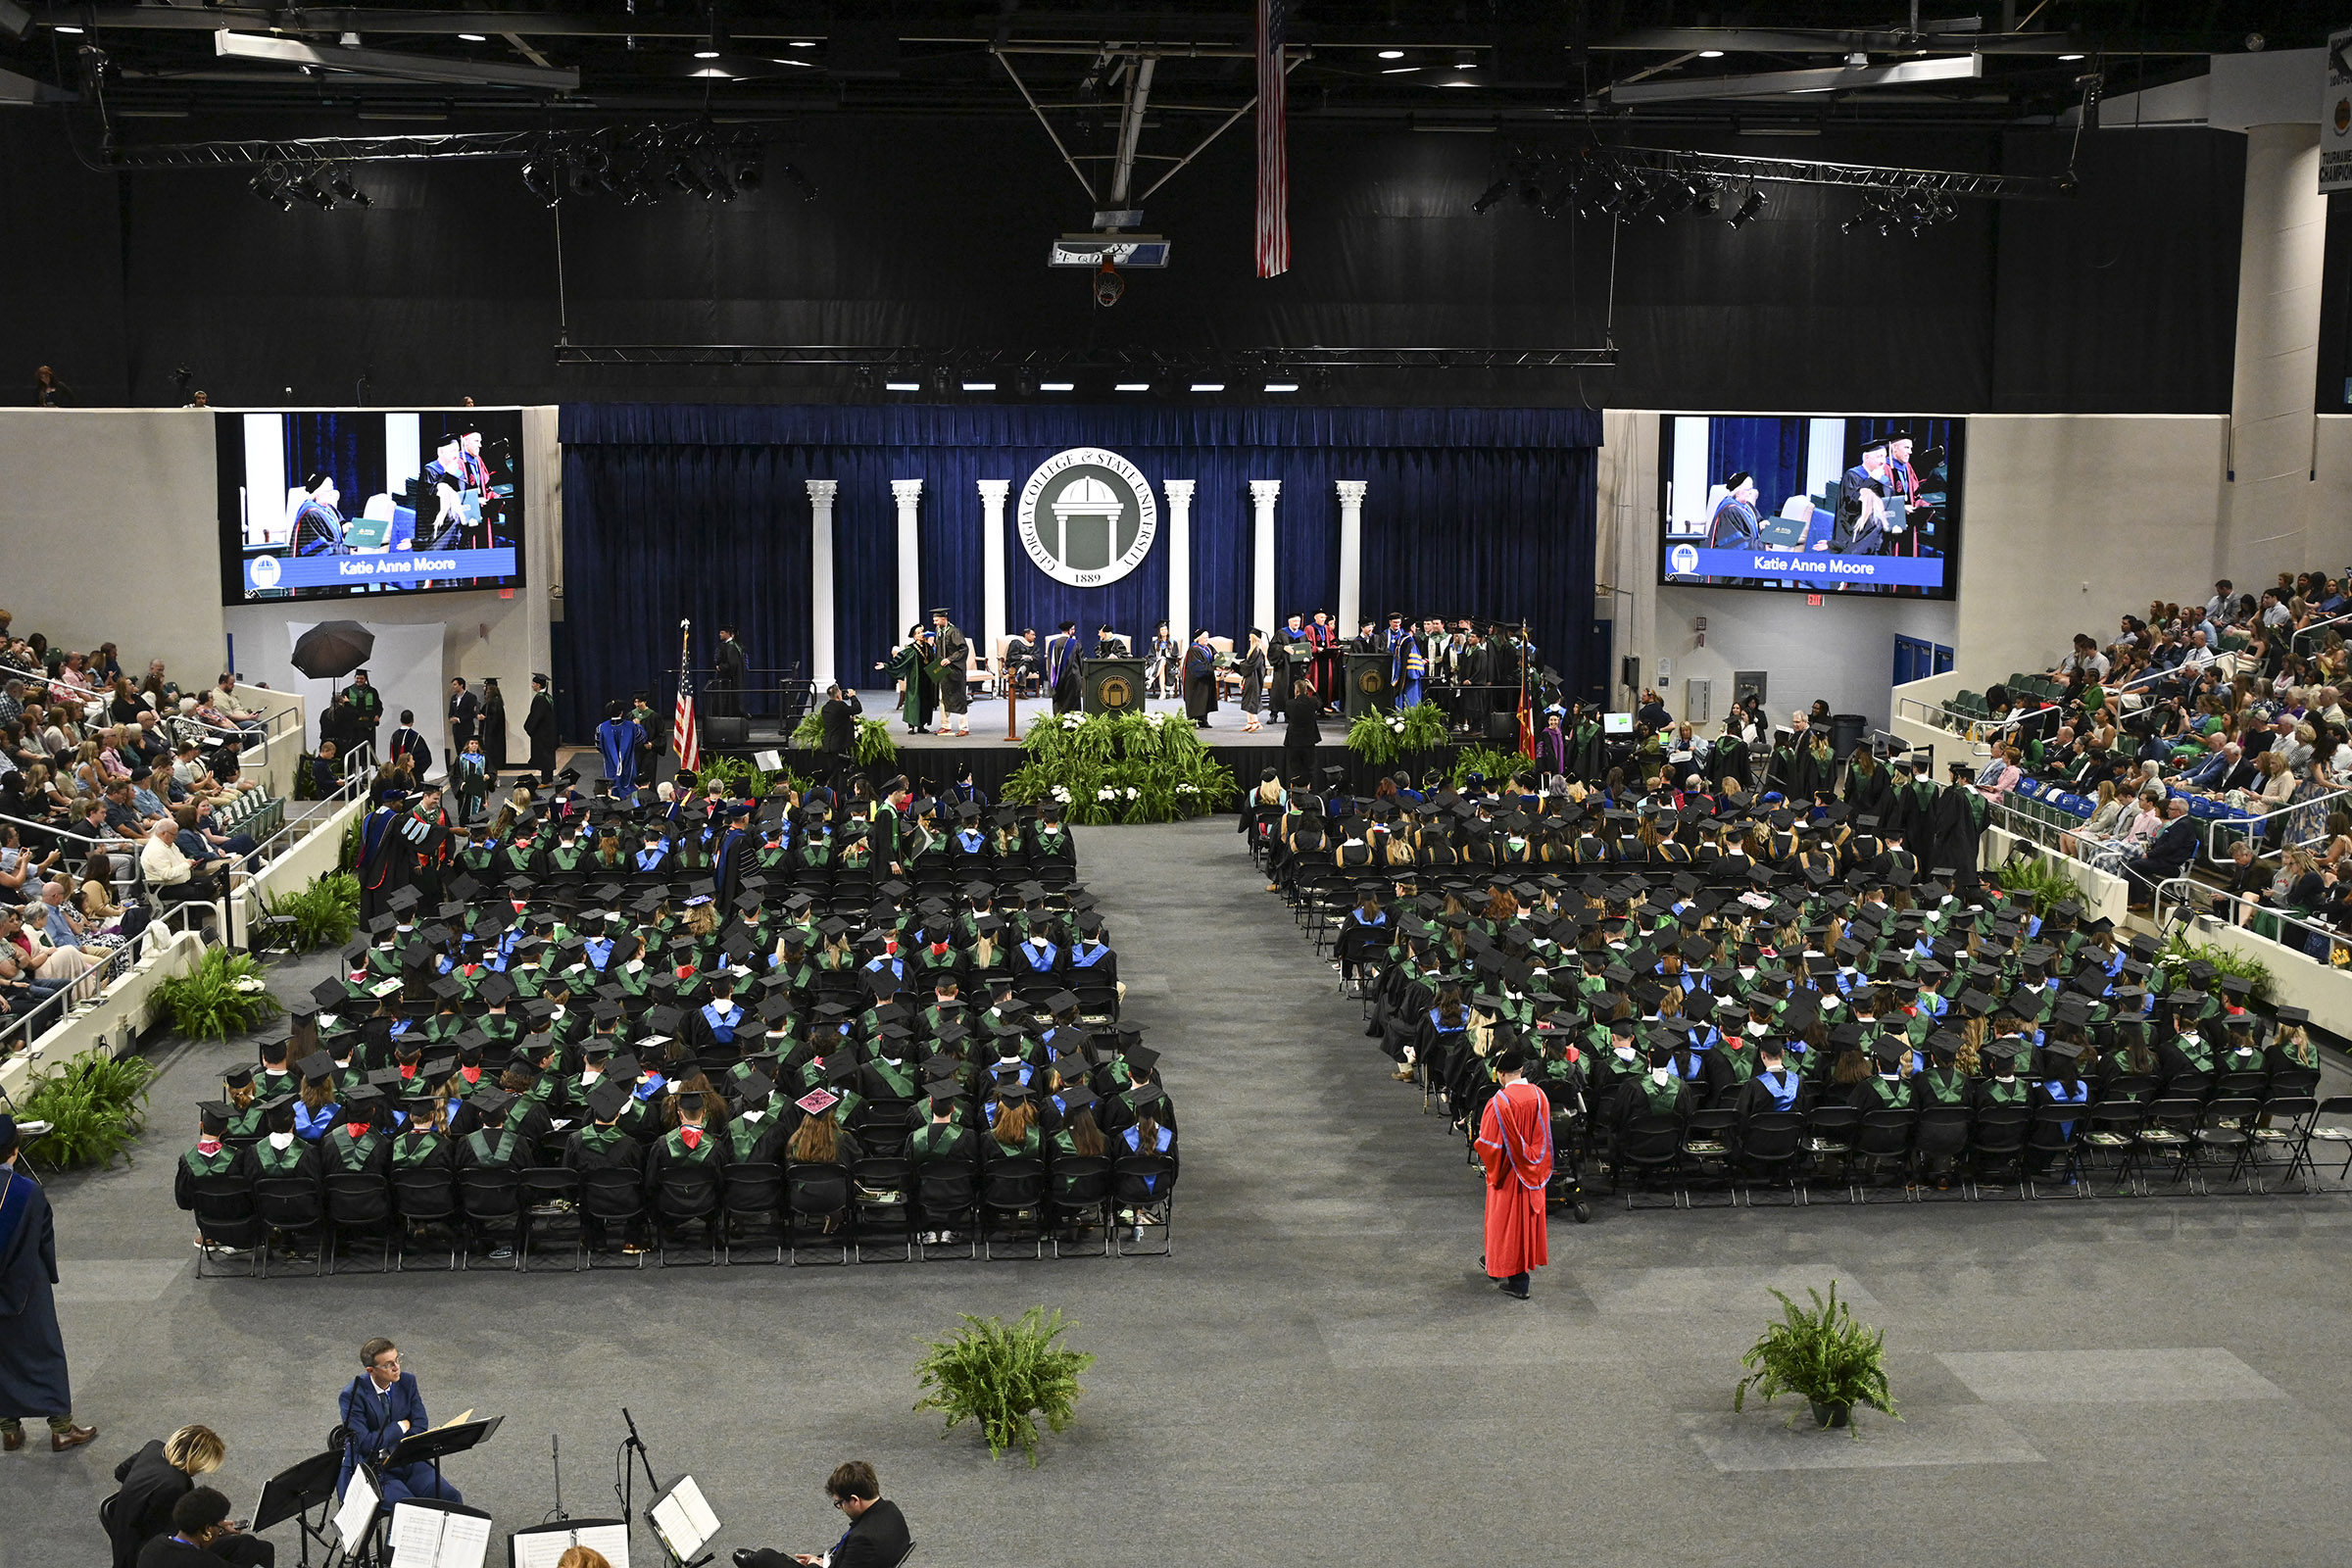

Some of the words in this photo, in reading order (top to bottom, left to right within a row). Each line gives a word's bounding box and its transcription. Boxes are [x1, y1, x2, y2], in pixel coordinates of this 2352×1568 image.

[1081, 451, 1093, 463] &
[1097, 454, 1139, 483] STATE
[1024, 454, 1076, 506] COLLEGE
[1124, 482, 1153, 569] UNIVERSITY
[1022, 511, 1055, 571] GEORGIA
[339, 561, 374, 575] Katie
[376, 559, 412, 573] Anne
[414, 557, 456, 571] Moore
[1754, 556, 1788, 570] Katie
[1789, 558, 1827, 572] Anne
[1830, 559, 1875, 574] Moore
[1075, 574, 1102, 583] 1889
[1807, 594, 1822, 606] EXIT
